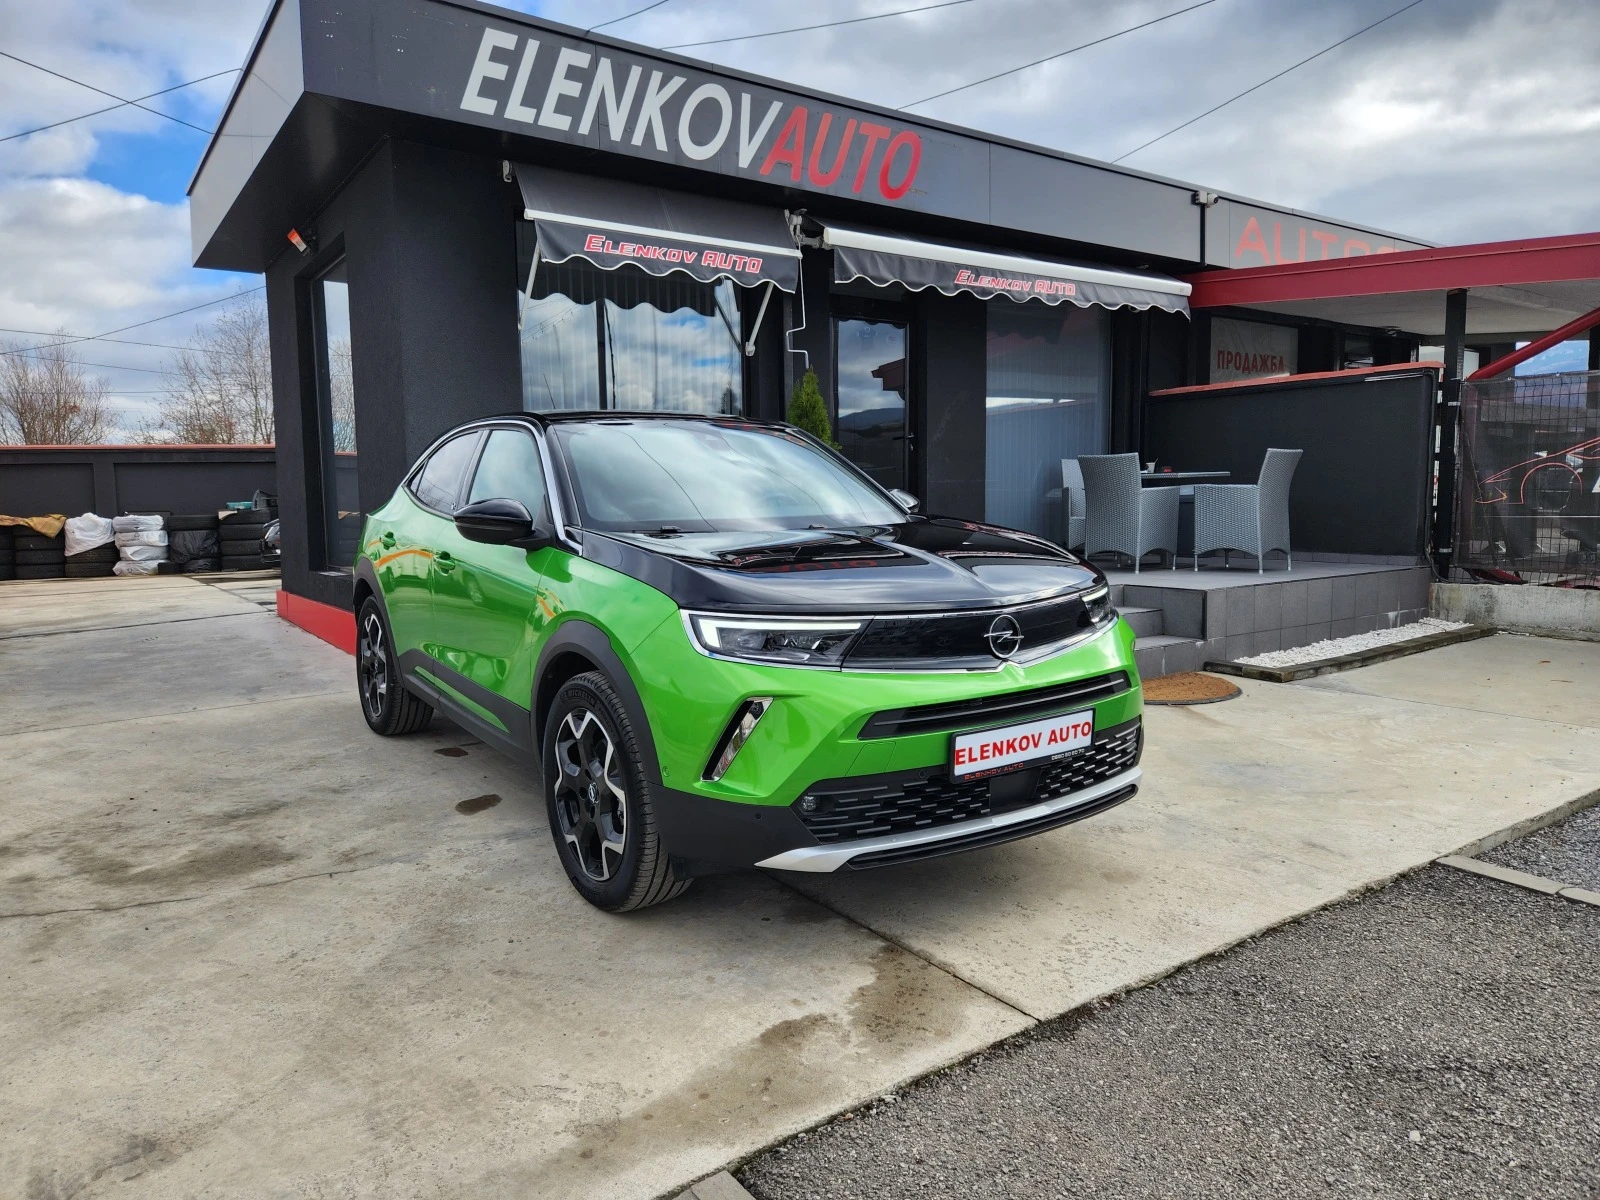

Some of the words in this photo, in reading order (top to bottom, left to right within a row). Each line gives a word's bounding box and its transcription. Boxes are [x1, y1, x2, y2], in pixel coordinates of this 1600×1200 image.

[584, 234, 697, 264] ELENKOV
[701, 250, 763, 274] AUTO
[954, 270, 1031, 292] ELENKOV
[1034, 279, 1076, 296] AUTO
[1216, 349, 1285, 374] ПРОДАЖБА
[955, 732, 1042, 766] ELENKOV
[1047, 721, 1092, 745] AUTO
[964, 767, 1002, 780] ELENKOV
[1003, 762, 1024, 772] AUTO
